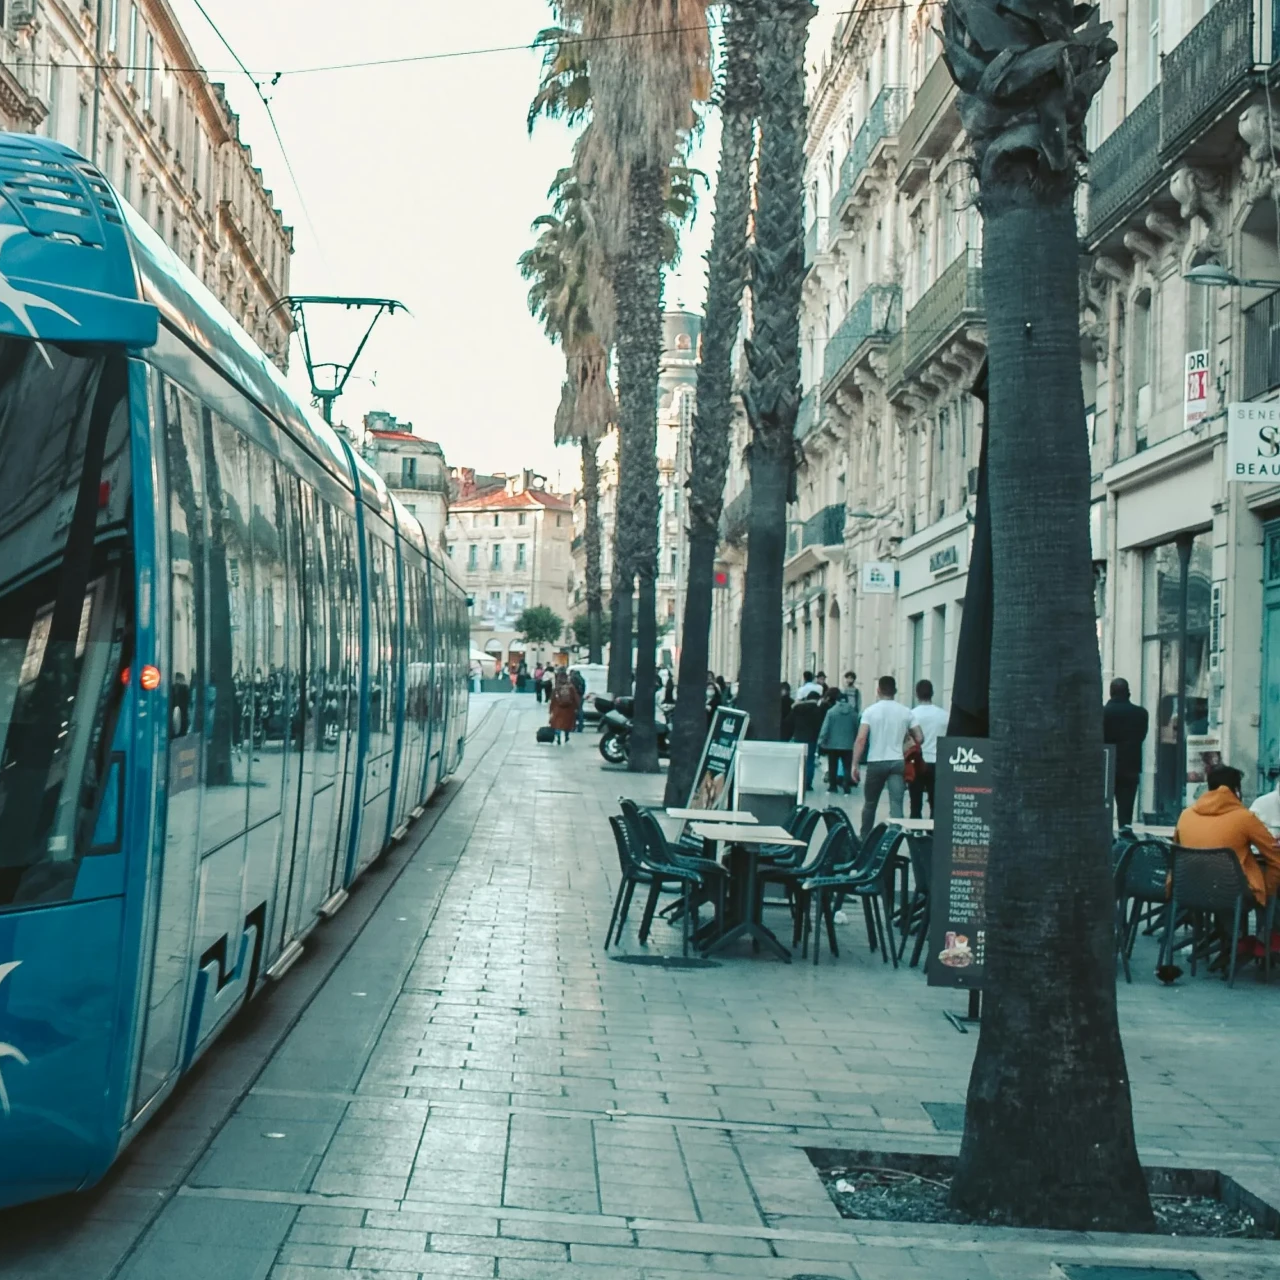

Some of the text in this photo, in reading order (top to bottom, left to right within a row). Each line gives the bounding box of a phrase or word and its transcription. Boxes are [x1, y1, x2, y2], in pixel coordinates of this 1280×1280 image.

[1237, 409, 1280, 420] SENE
[953, 764, 977, 773] HALAL
[953, 800, 978, 808] POULET
[953, 808, 973, 816] KEFTA
[953, 815, 982, 824] TENDERS
[952, 830, 978, 839] FALAFEL
[952, 837, 978, 846] FALAFEL
[950, 879, 971, 887] KEBAB
[950, 886, 974, 894] POULET
[949, 894, 969, 902] KEFTA
[949, 901, 978, 910] TENDERS
[949, 908, 975, 917] FALAFEL
